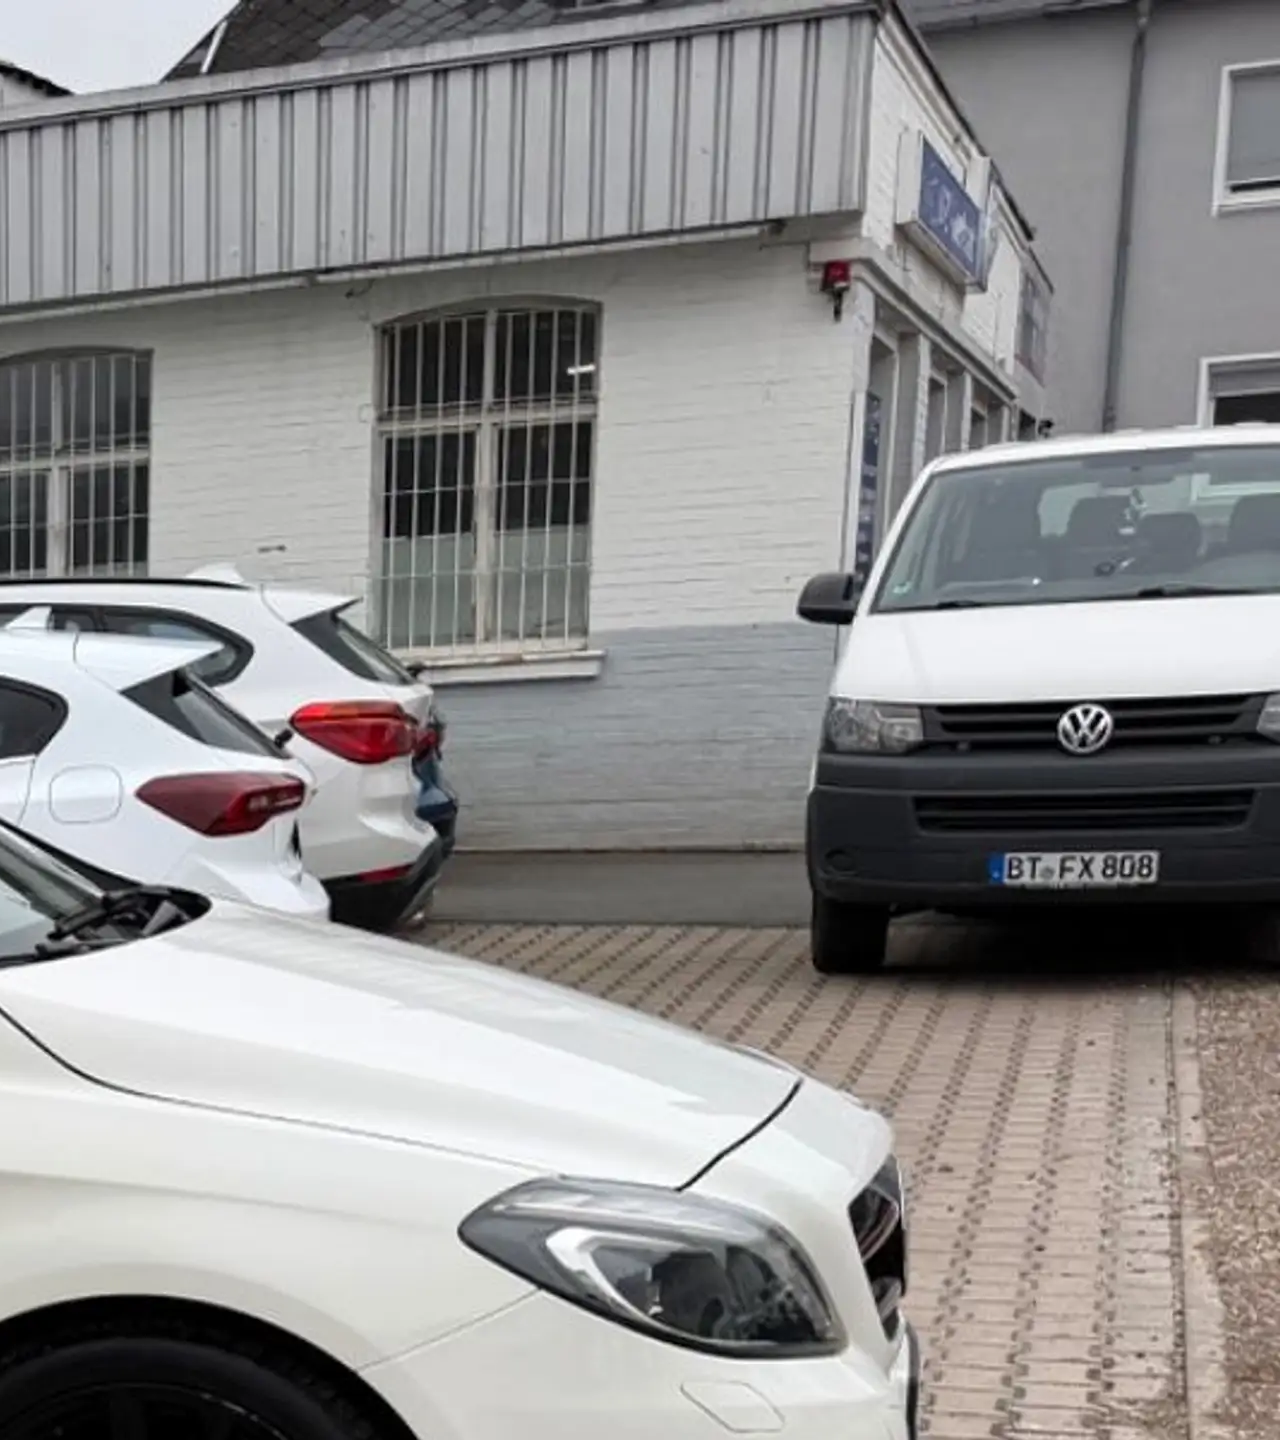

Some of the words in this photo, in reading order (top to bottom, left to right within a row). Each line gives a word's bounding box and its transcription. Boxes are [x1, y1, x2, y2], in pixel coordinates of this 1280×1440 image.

[1007, 856, 1042, 880] BT
[1059, 856, 1094, 880] FX
[1101, 855, 1154, 879] 808
